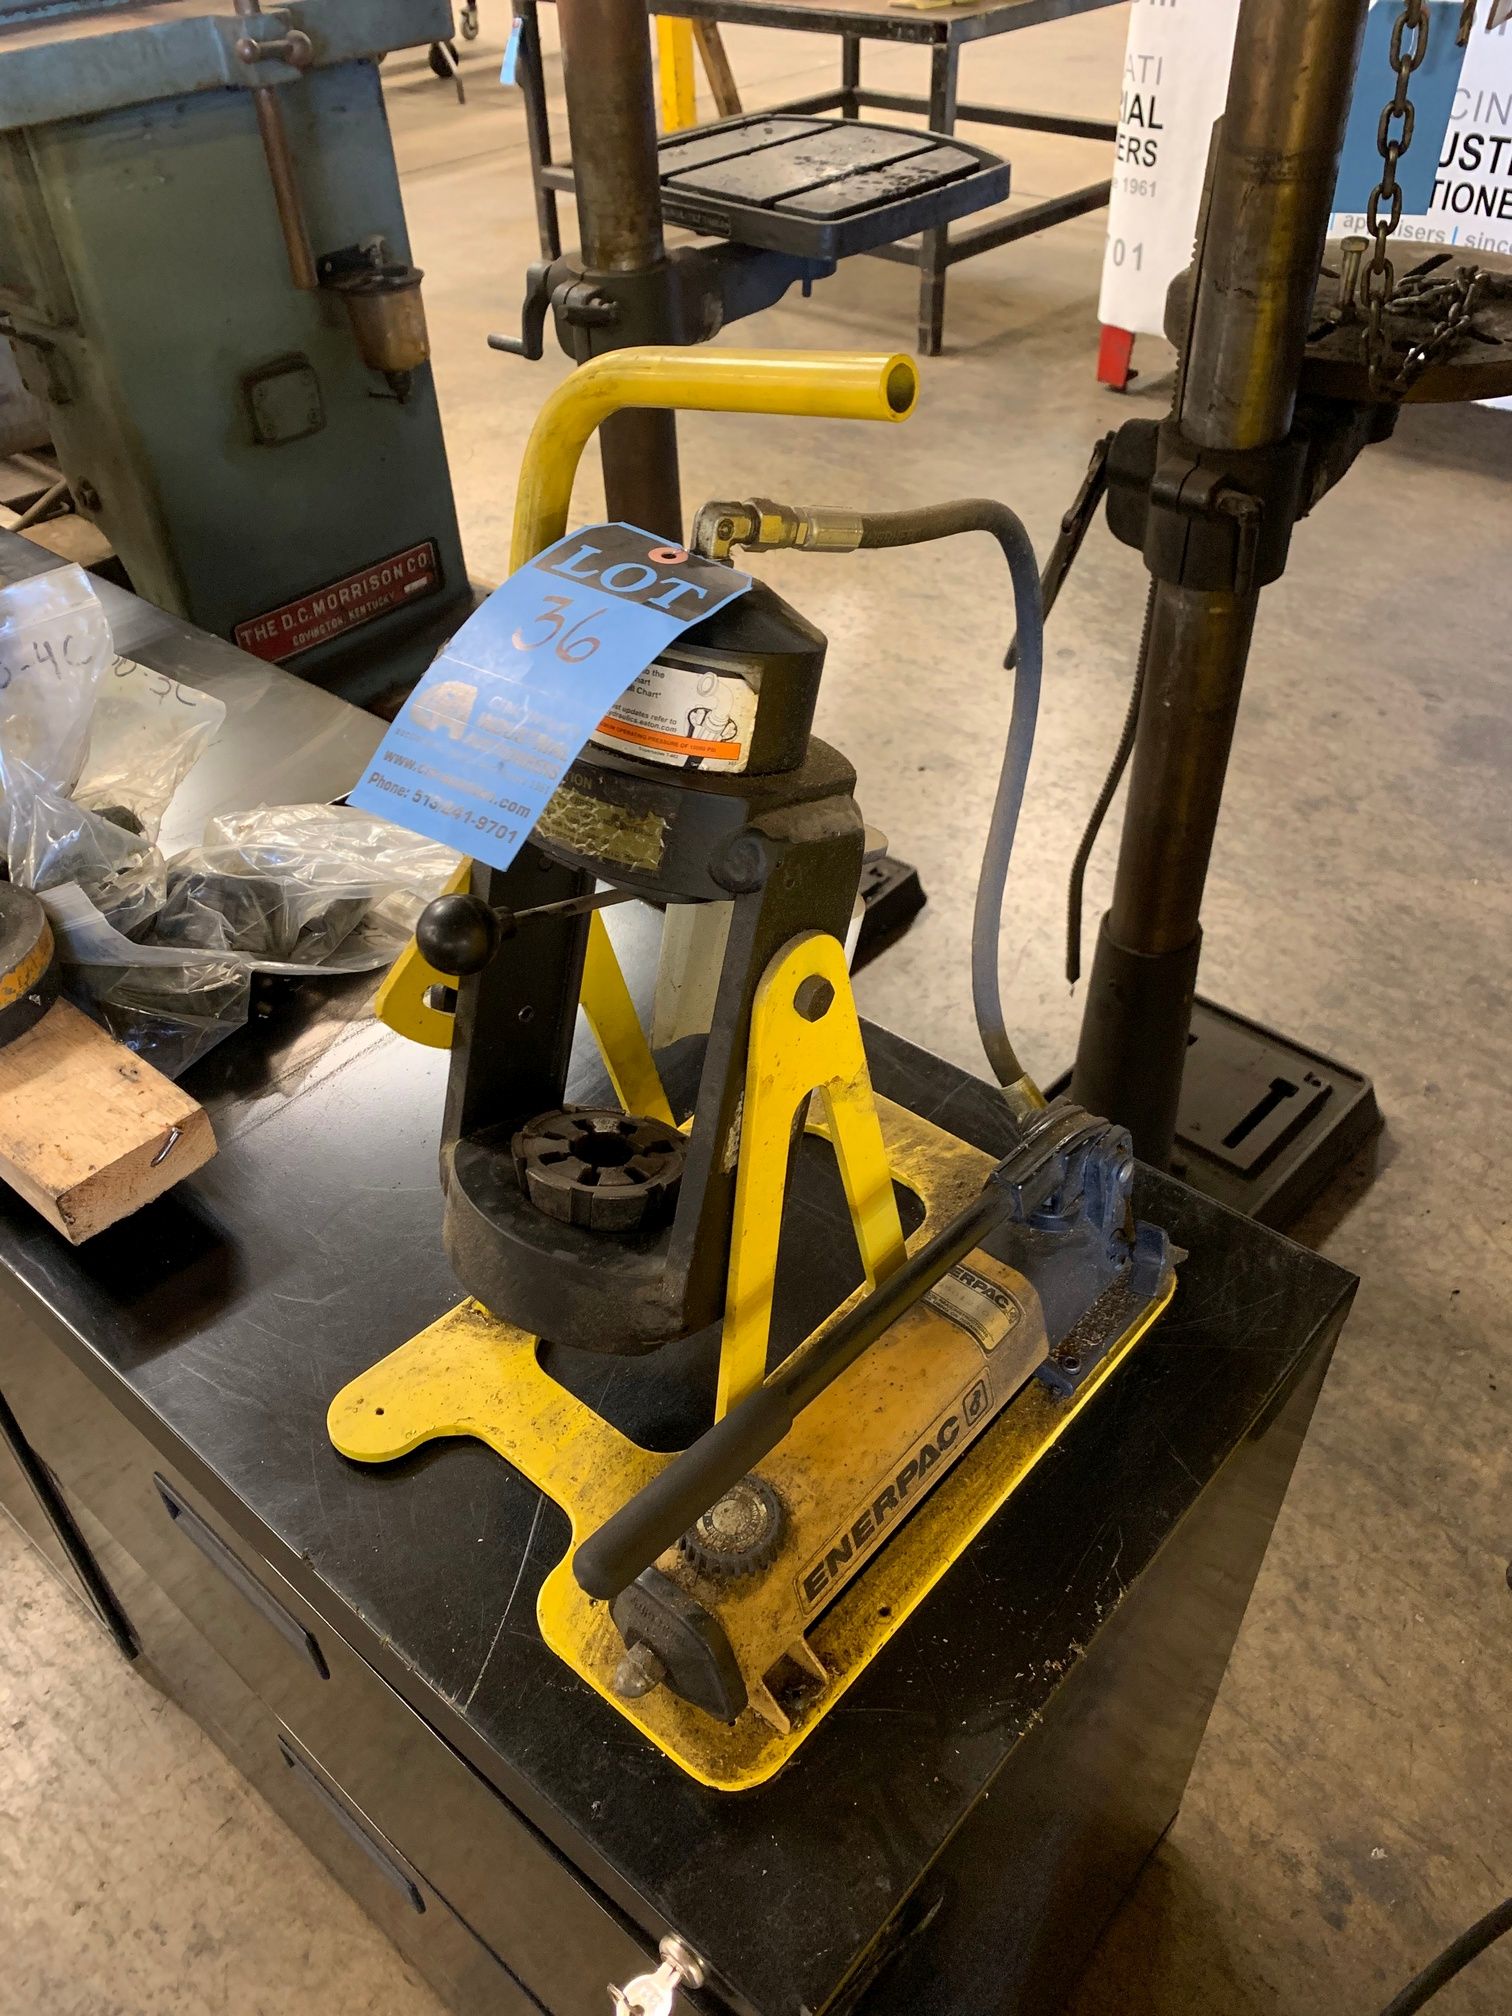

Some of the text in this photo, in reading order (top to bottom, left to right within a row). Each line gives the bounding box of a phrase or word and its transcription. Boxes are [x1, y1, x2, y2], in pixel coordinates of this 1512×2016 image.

[1119, 90, 1163, 129] IAL
[1117, 133, 1158, 167] ERS
[1438, 131, 1512, 176] UST
[1122, 177, 1157, 198] 1961
[1343, 214, 1446, 243] apisers
[1112, 237, 1143, 272] 01
[550, 544, 710, 610] LOT
[240, 620, 278, 647] THE
[312, 564, 404, 618] MORRISON
[511, 594, 608, 664] 36
[651, 669, 665, 679] the
[622, 706, 649, 720] updates
[650, 715, 668, 723] refer
[367, 771, 409, 799] Phone:
[568, 773, 593, 790] ION
[803, 1415, 960, 1603] ENERPAC
